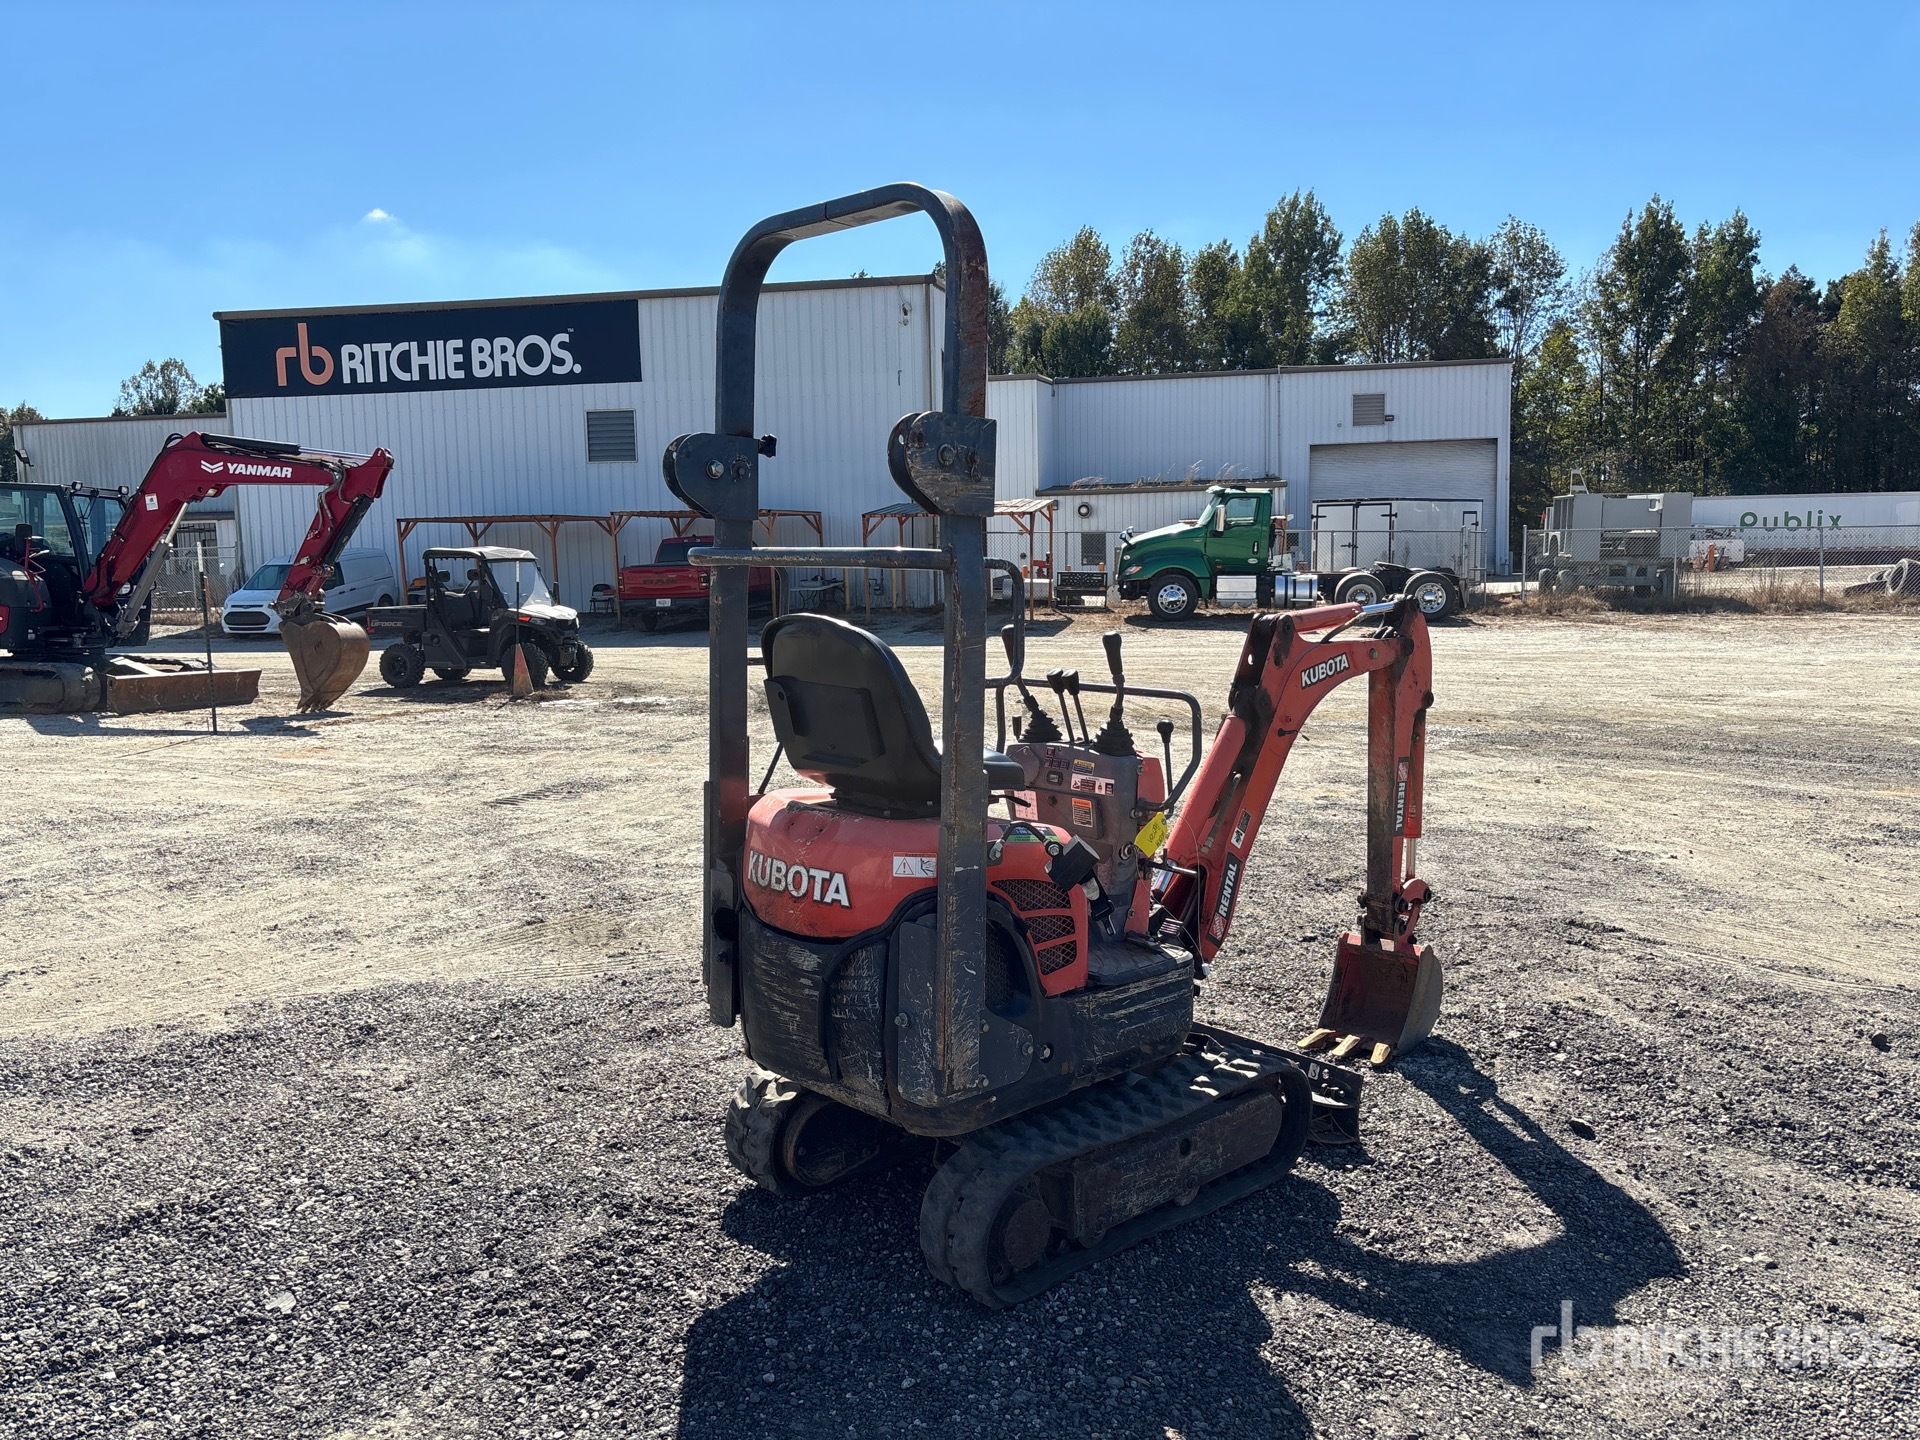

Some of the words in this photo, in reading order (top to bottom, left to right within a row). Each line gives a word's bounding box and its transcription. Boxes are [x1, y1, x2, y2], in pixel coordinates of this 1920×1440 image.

[275, 322, 334, 387] rb
[340, 339, 465, 385] RITCHIE
[471, 333, 582, 379] BROS.
[227, 462, 292, 478] YANMAR
[1740, 509, 1842, 532] Publix
[1301, 653, 1349, 687] KUBOTA
[1396, 782, 1406, 831] RENTAL
[748, 850, 851, 908] KUBOTA
[1218, 862, 1238, 917] RENTAL
